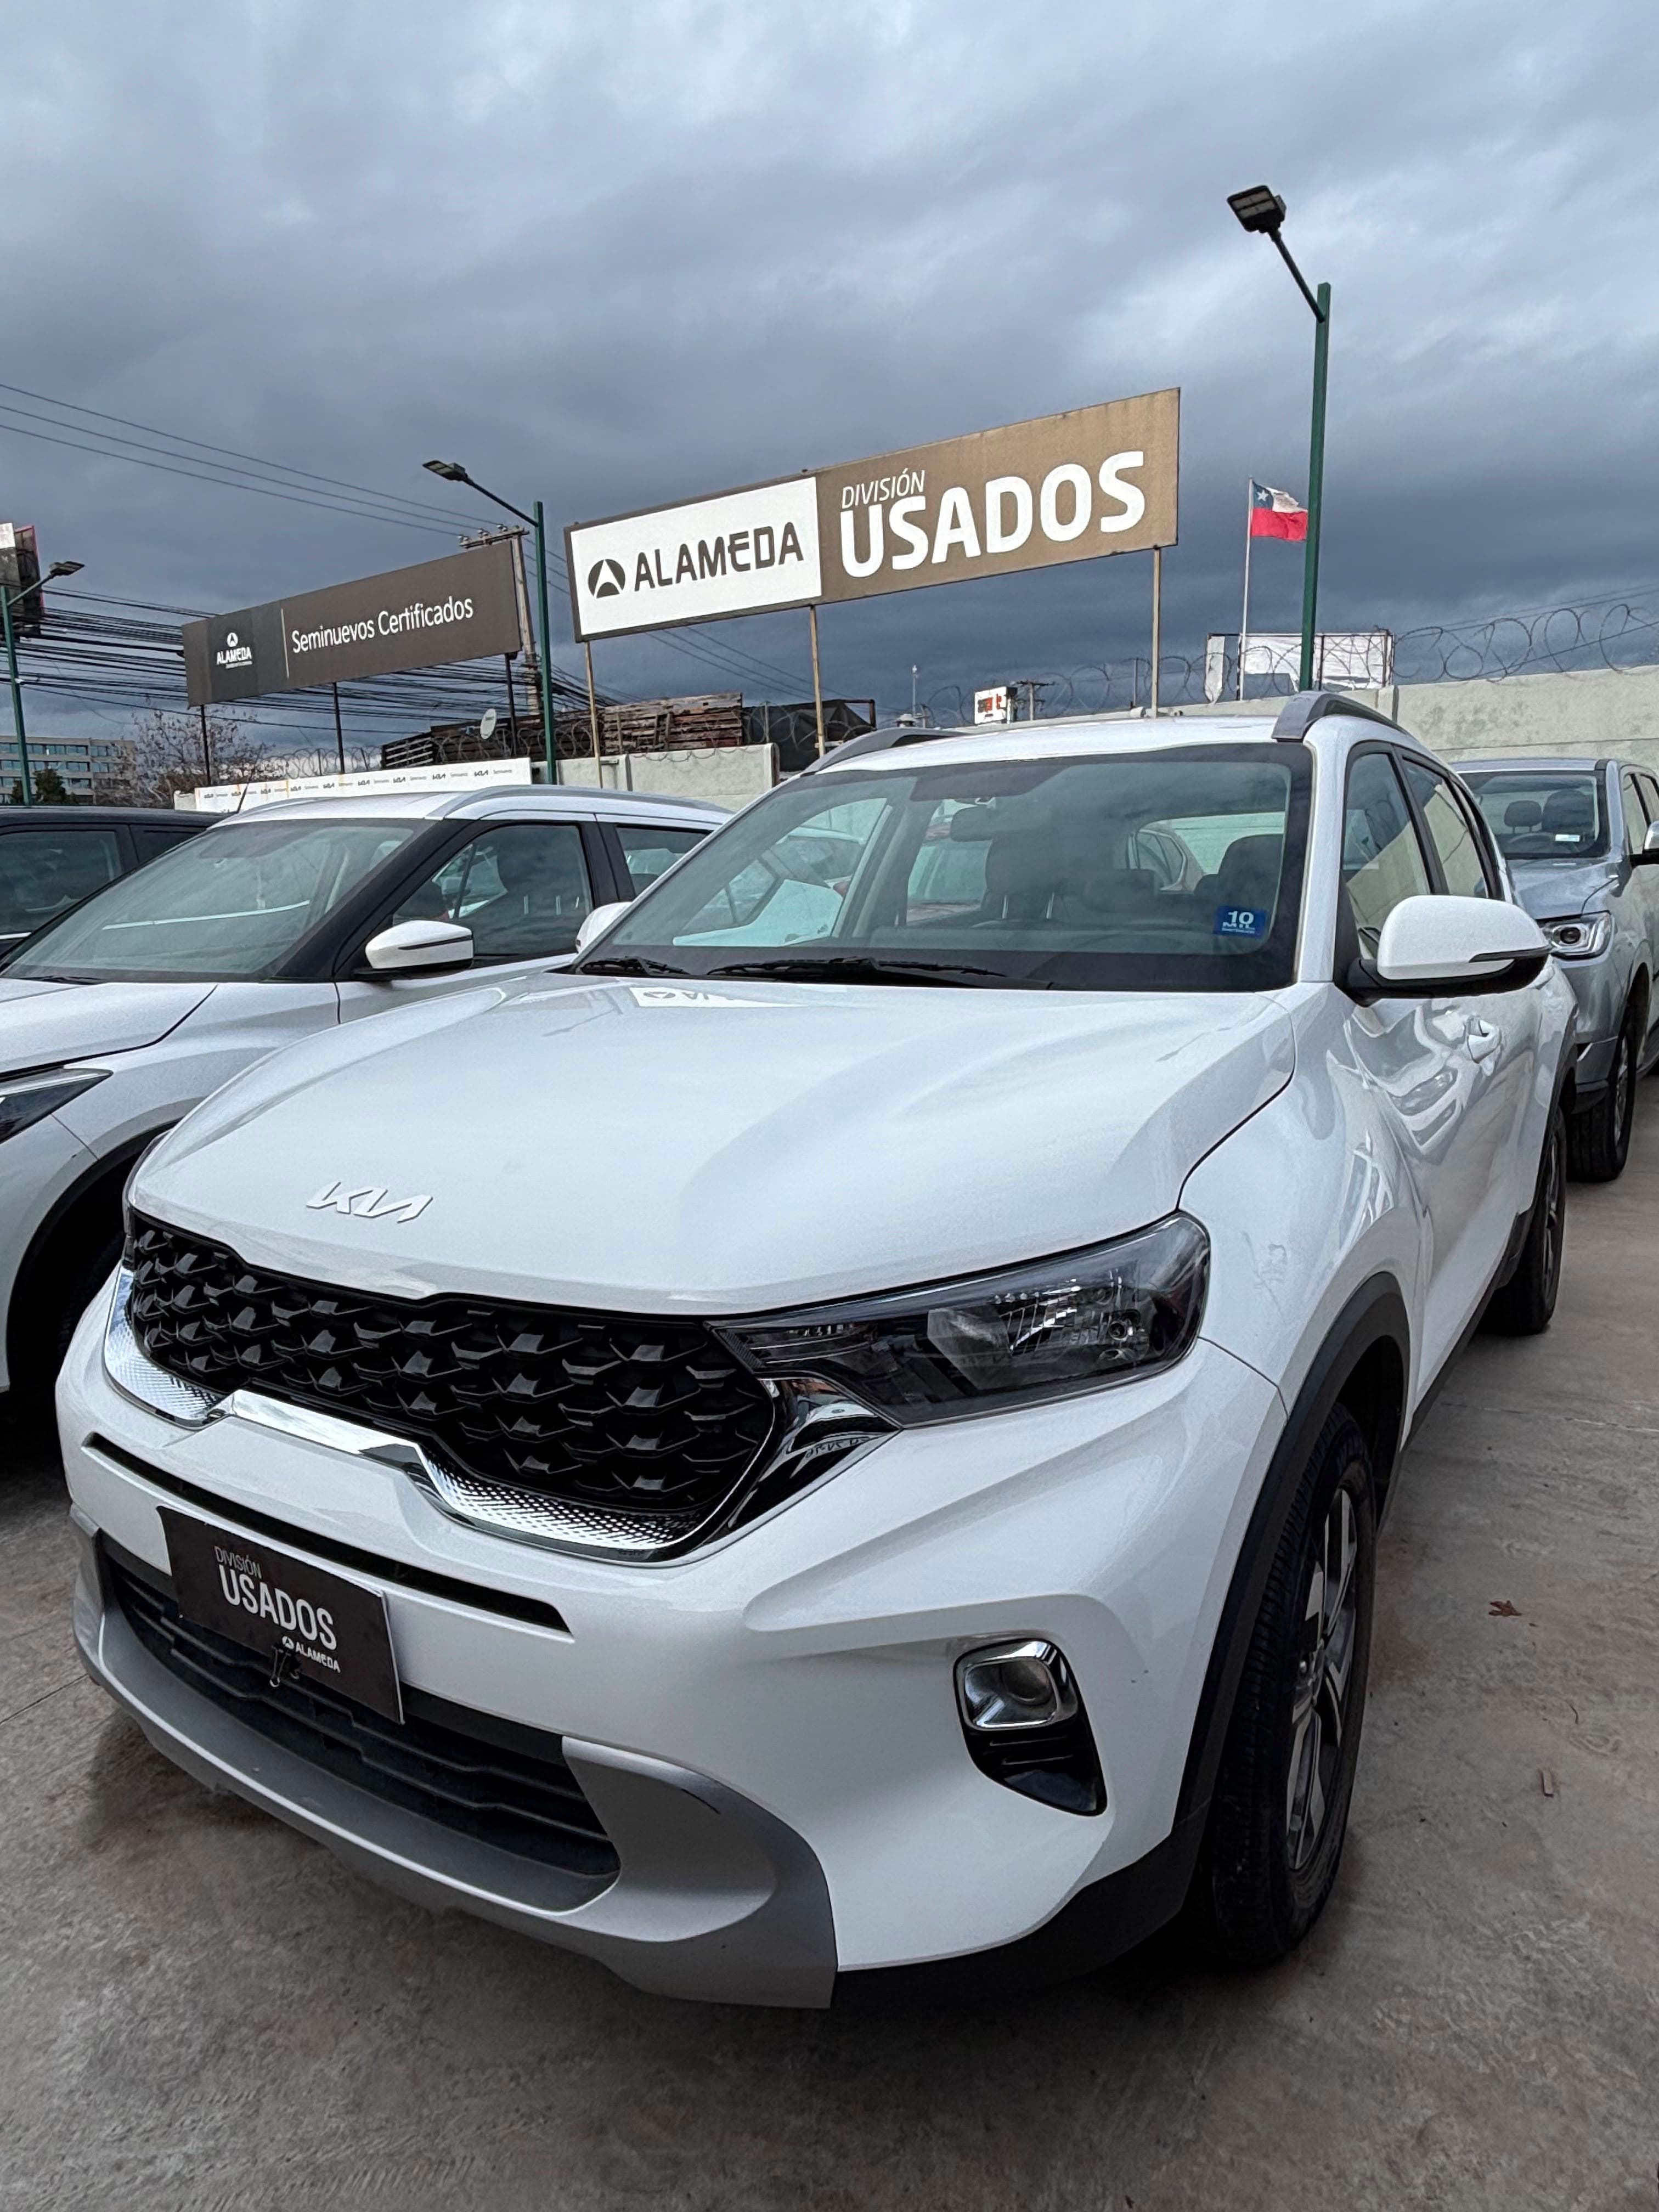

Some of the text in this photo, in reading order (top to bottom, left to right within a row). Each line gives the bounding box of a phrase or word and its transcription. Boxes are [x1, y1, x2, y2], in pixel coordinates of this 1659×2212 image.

[840, 467, 926, 509] DIVISIÓN
[840, 451, 1146, 578] USADOS
[634, 521, 804, 592] ALAMEDA
[292, 596, 474, 653] Seminuevos Certificados
[216, 646, 252, 665] ALAMEDA
[1228, 911, 1254, 925] 10
[306, 1178, 433, 1224] KIA
[214, 1545, 262, 1579] DIVISIÓN
[218, 1564, 337, 1650] USADOS
[295, 1641, 341, 1673] ALAMEDA
